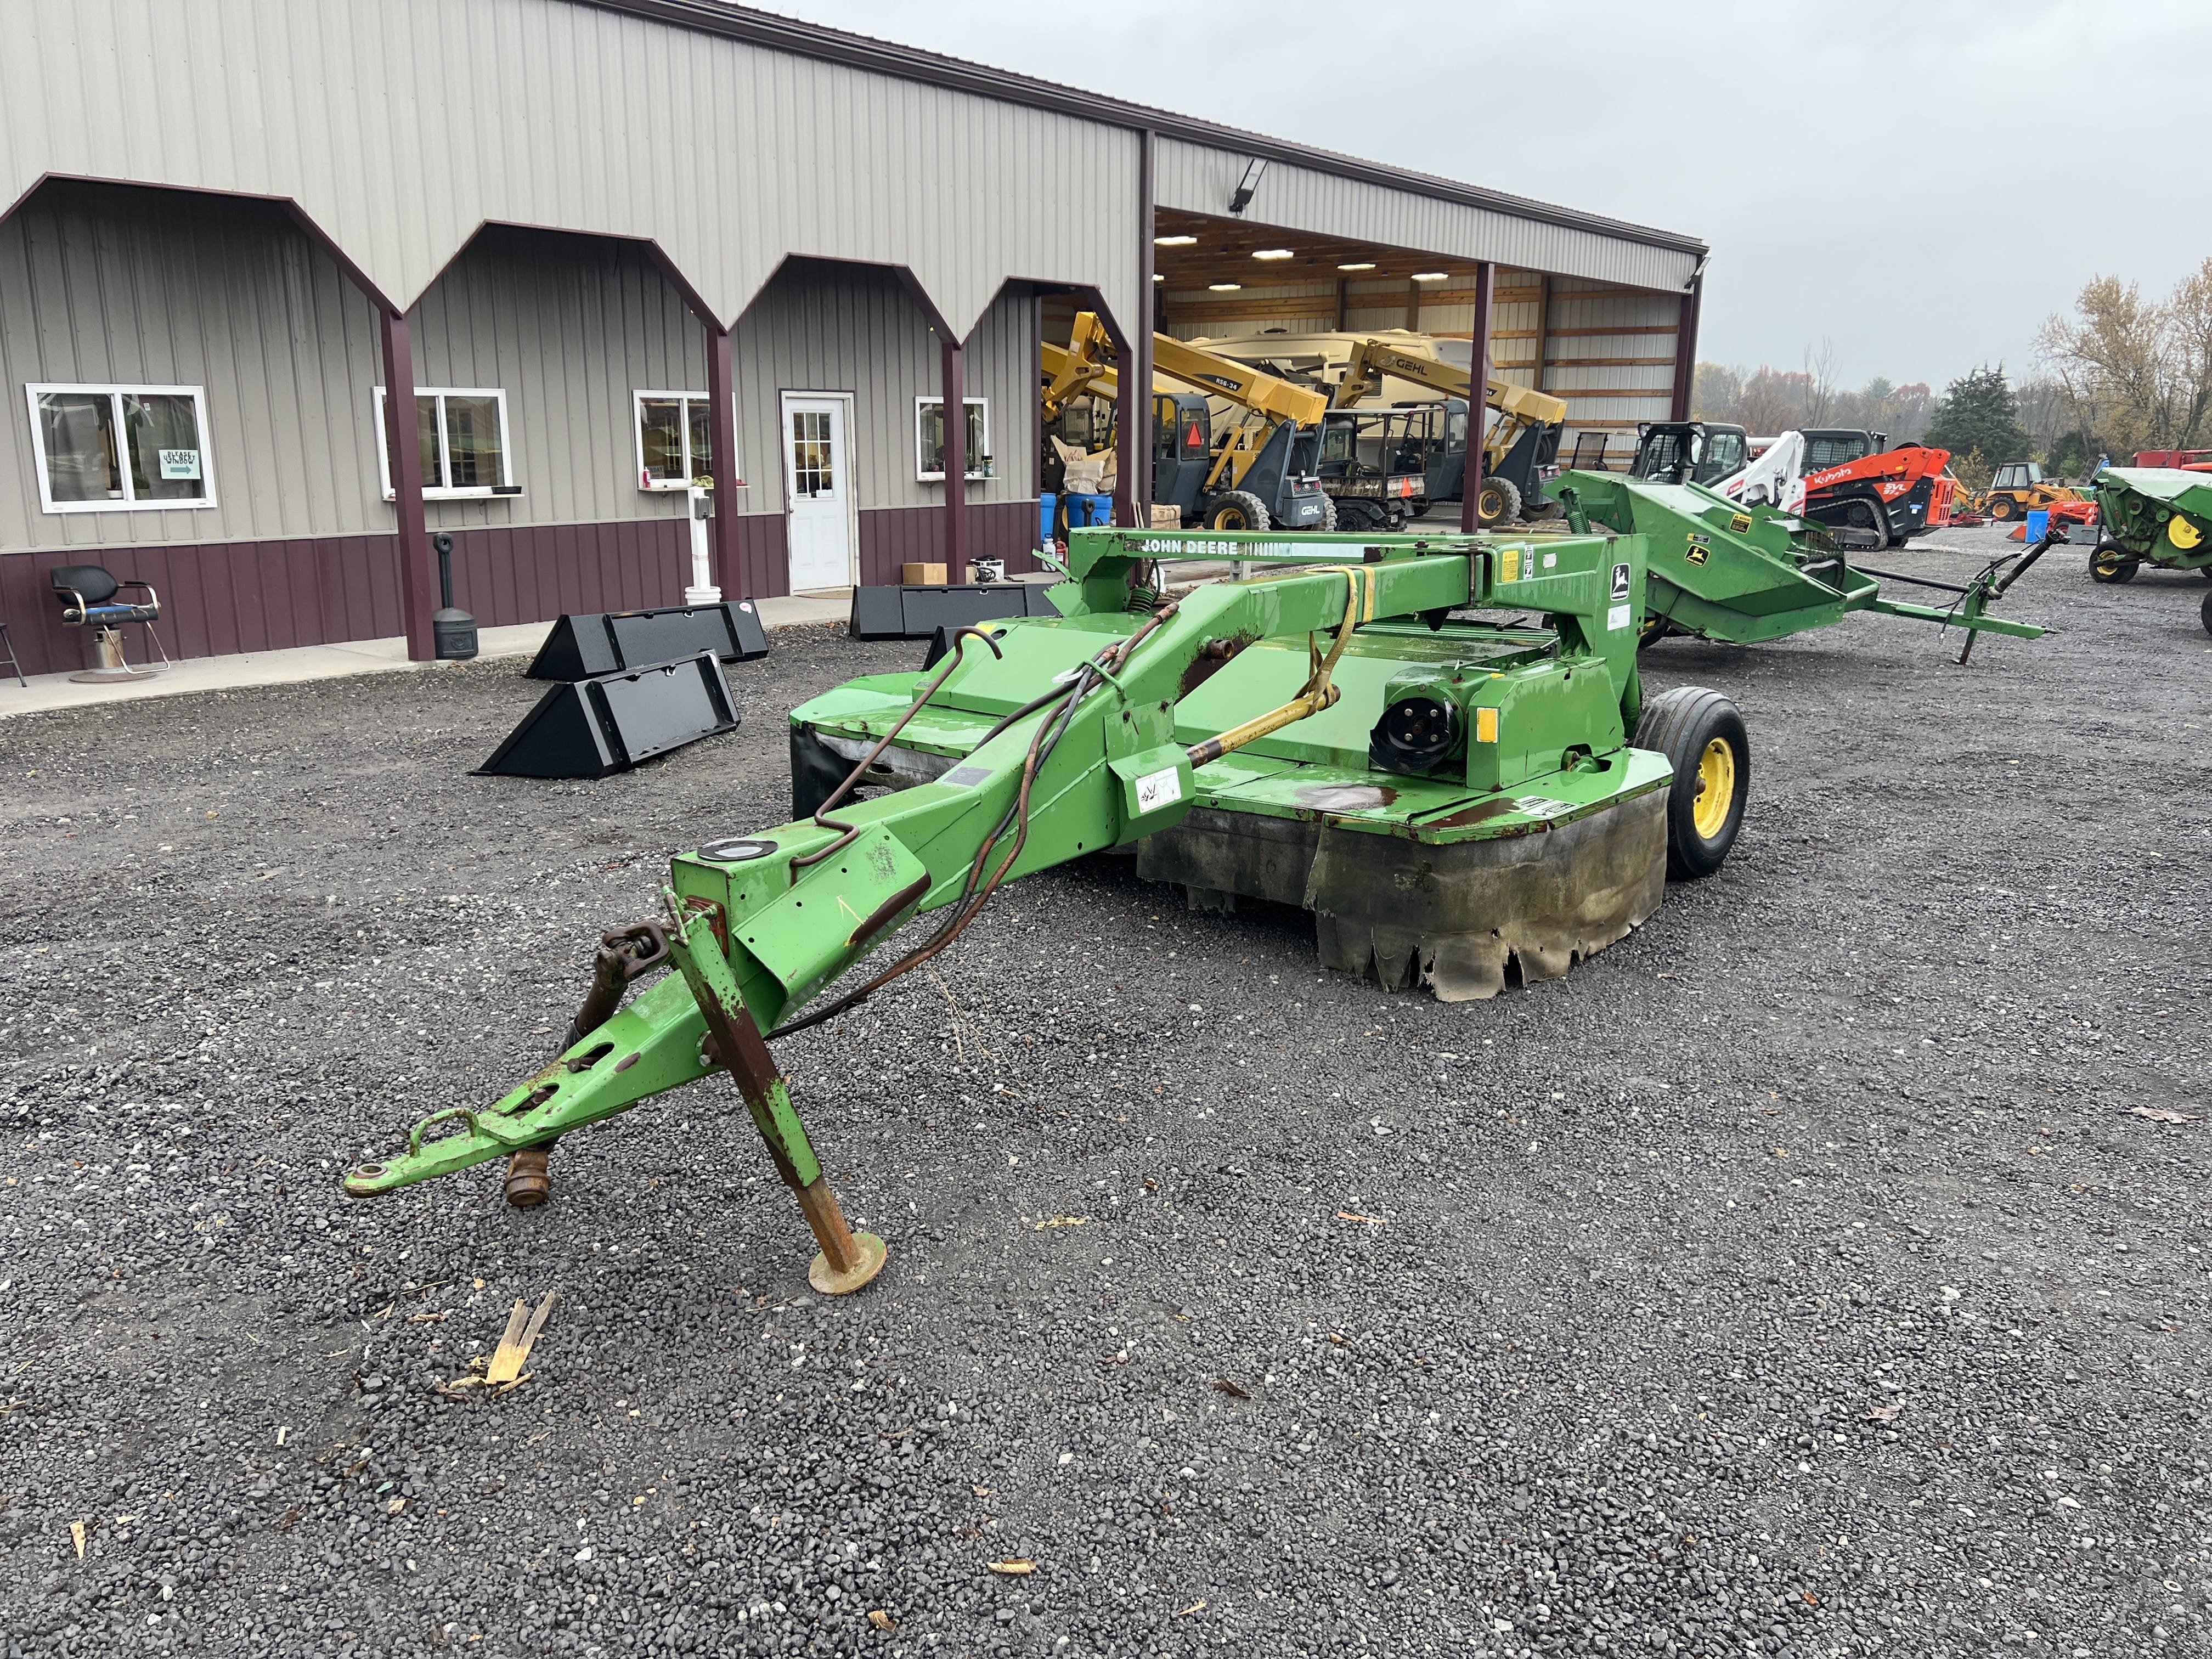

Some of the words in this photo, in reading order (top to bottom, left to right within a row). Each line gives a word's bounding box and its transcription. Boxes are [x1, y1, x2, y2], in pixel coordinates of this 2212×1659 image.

[1396, 359, 1427, 376] GEHL
[1814, 468, 1852, 484] Kubota
[1883, 483, 1906, 491] SVL
[1301, 505, 1320, 516] GEHL
[1141, 539, 1181, 552] JOHN
[1187, 540, 1238, 555] DEERE
